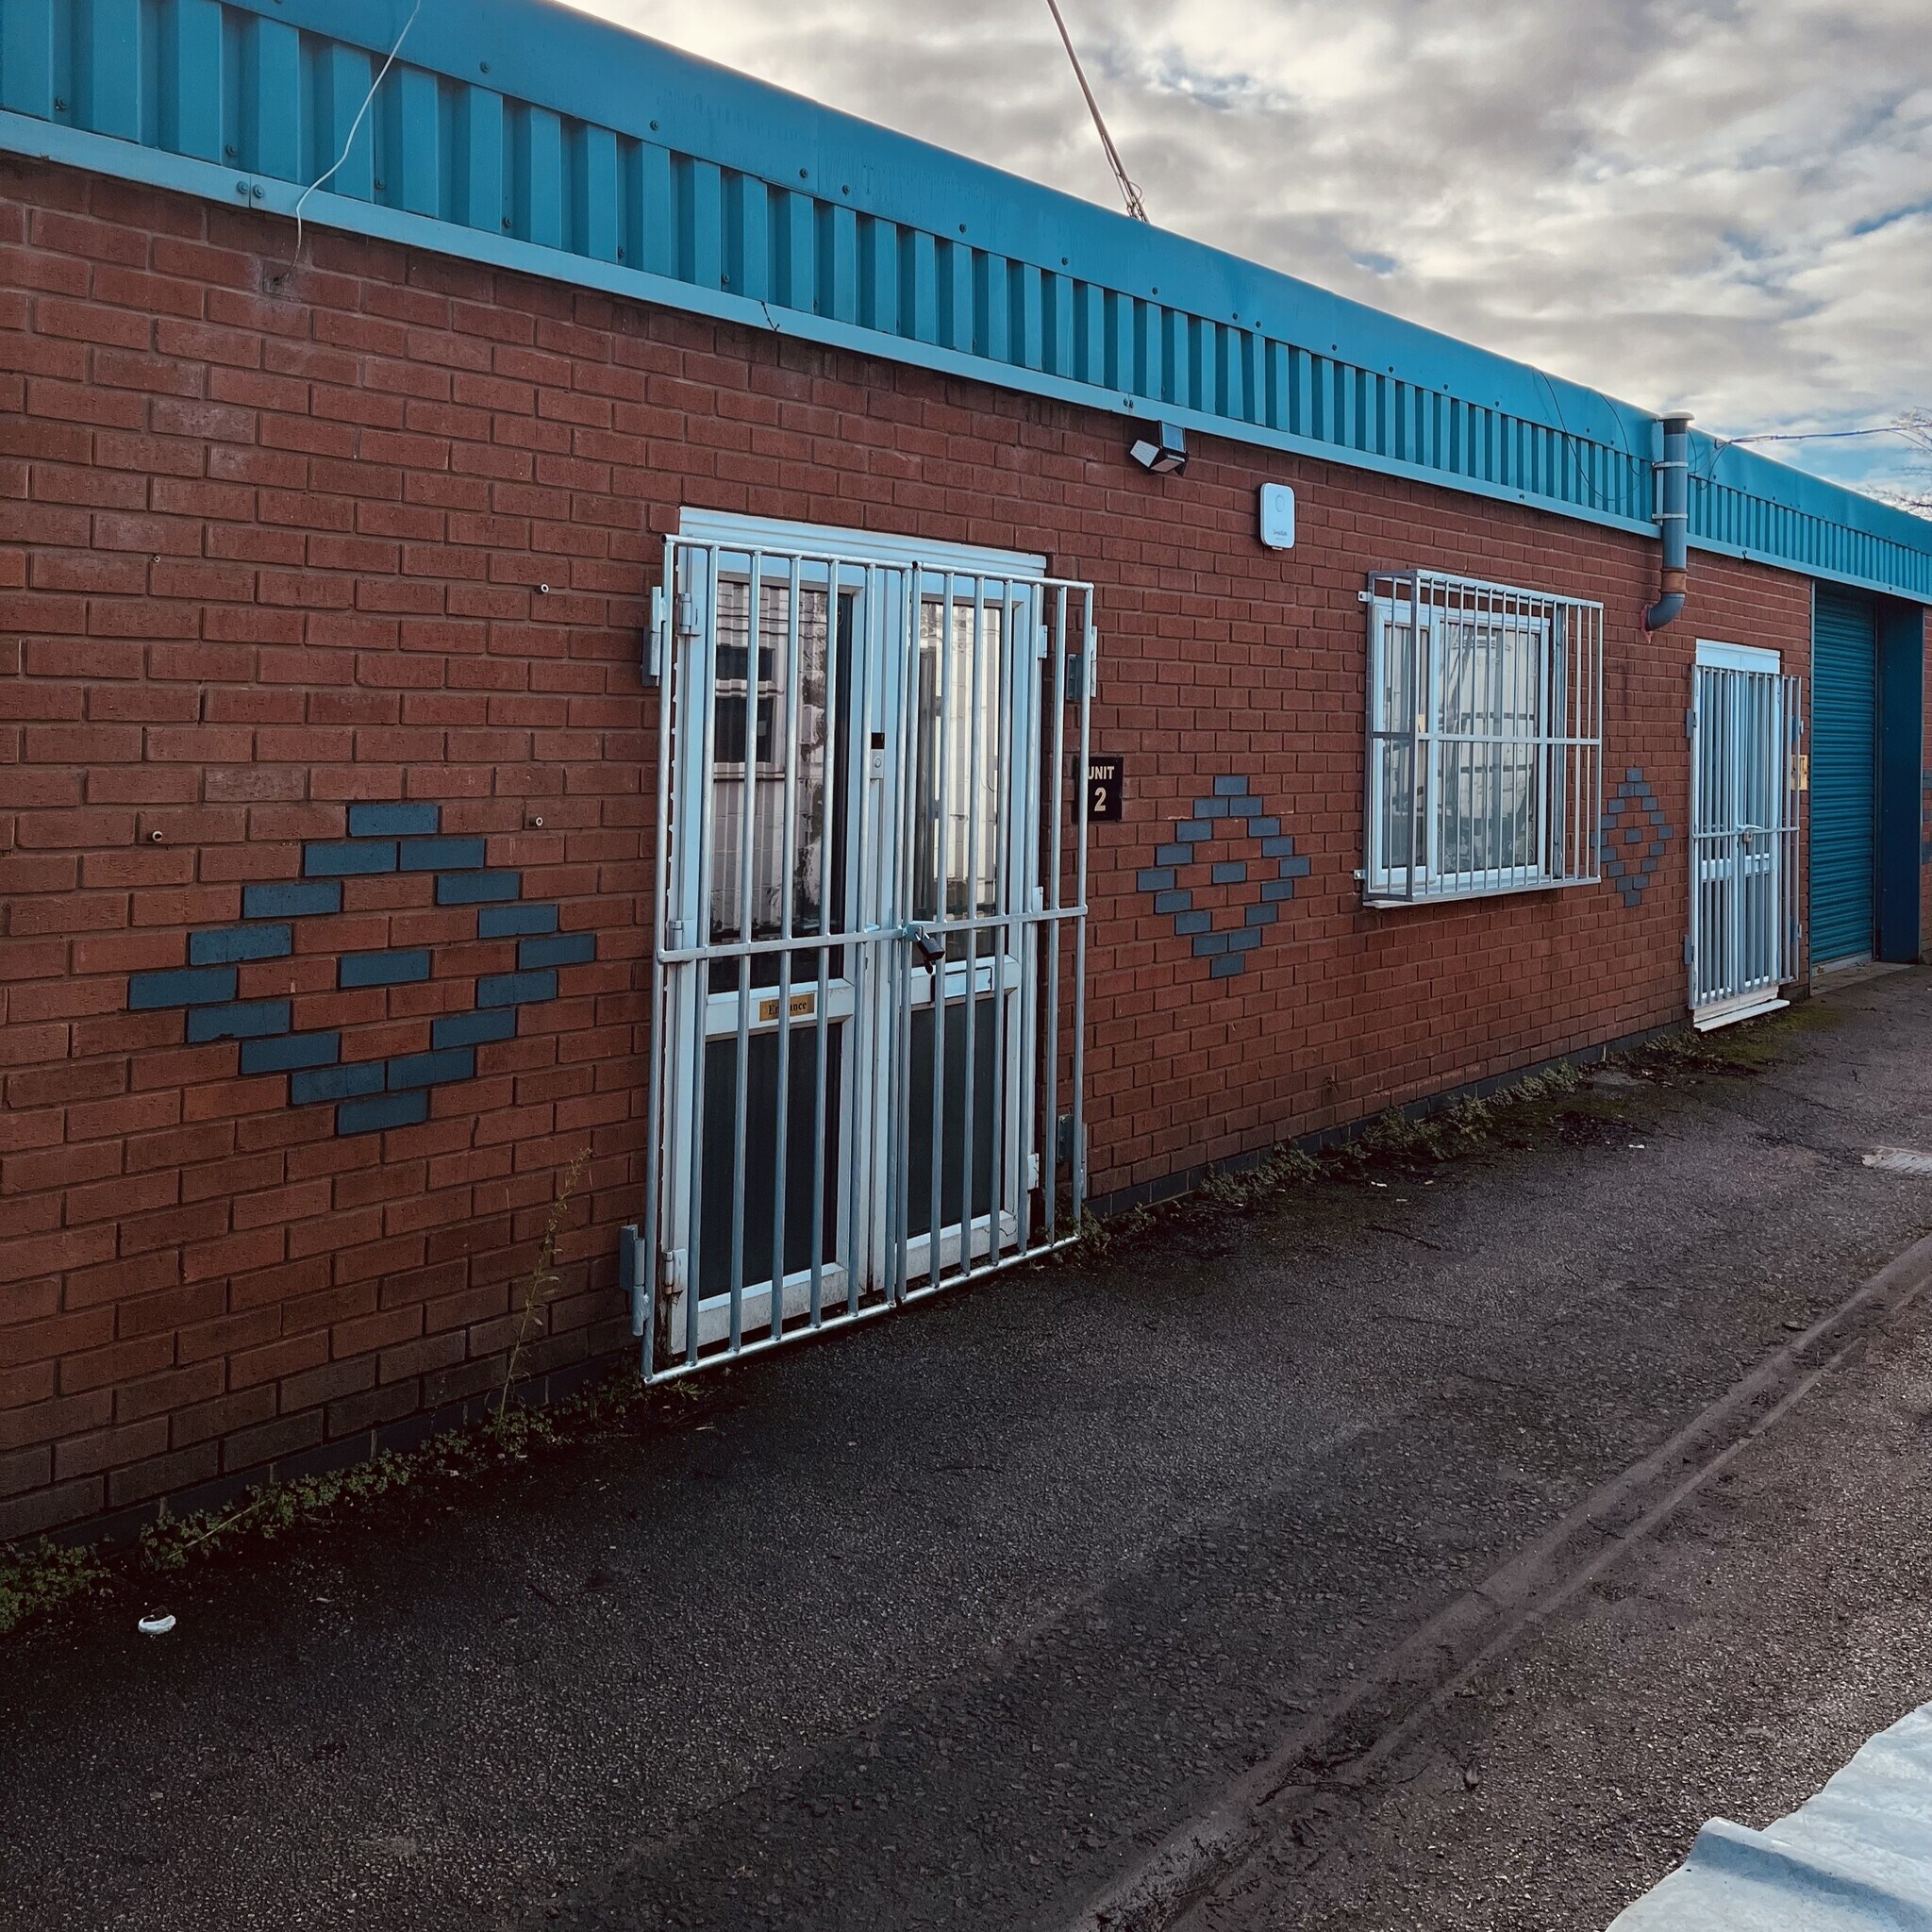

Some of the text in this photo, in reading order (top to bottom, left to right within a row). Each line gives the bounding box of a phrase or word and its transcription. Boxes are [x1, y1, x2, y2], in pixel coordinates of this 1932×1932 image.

[1088, 766, 1115, 780] UNIT
[1094, 787, 1107, 811] 2
[768, 1002, 808, 1015] Ennce
